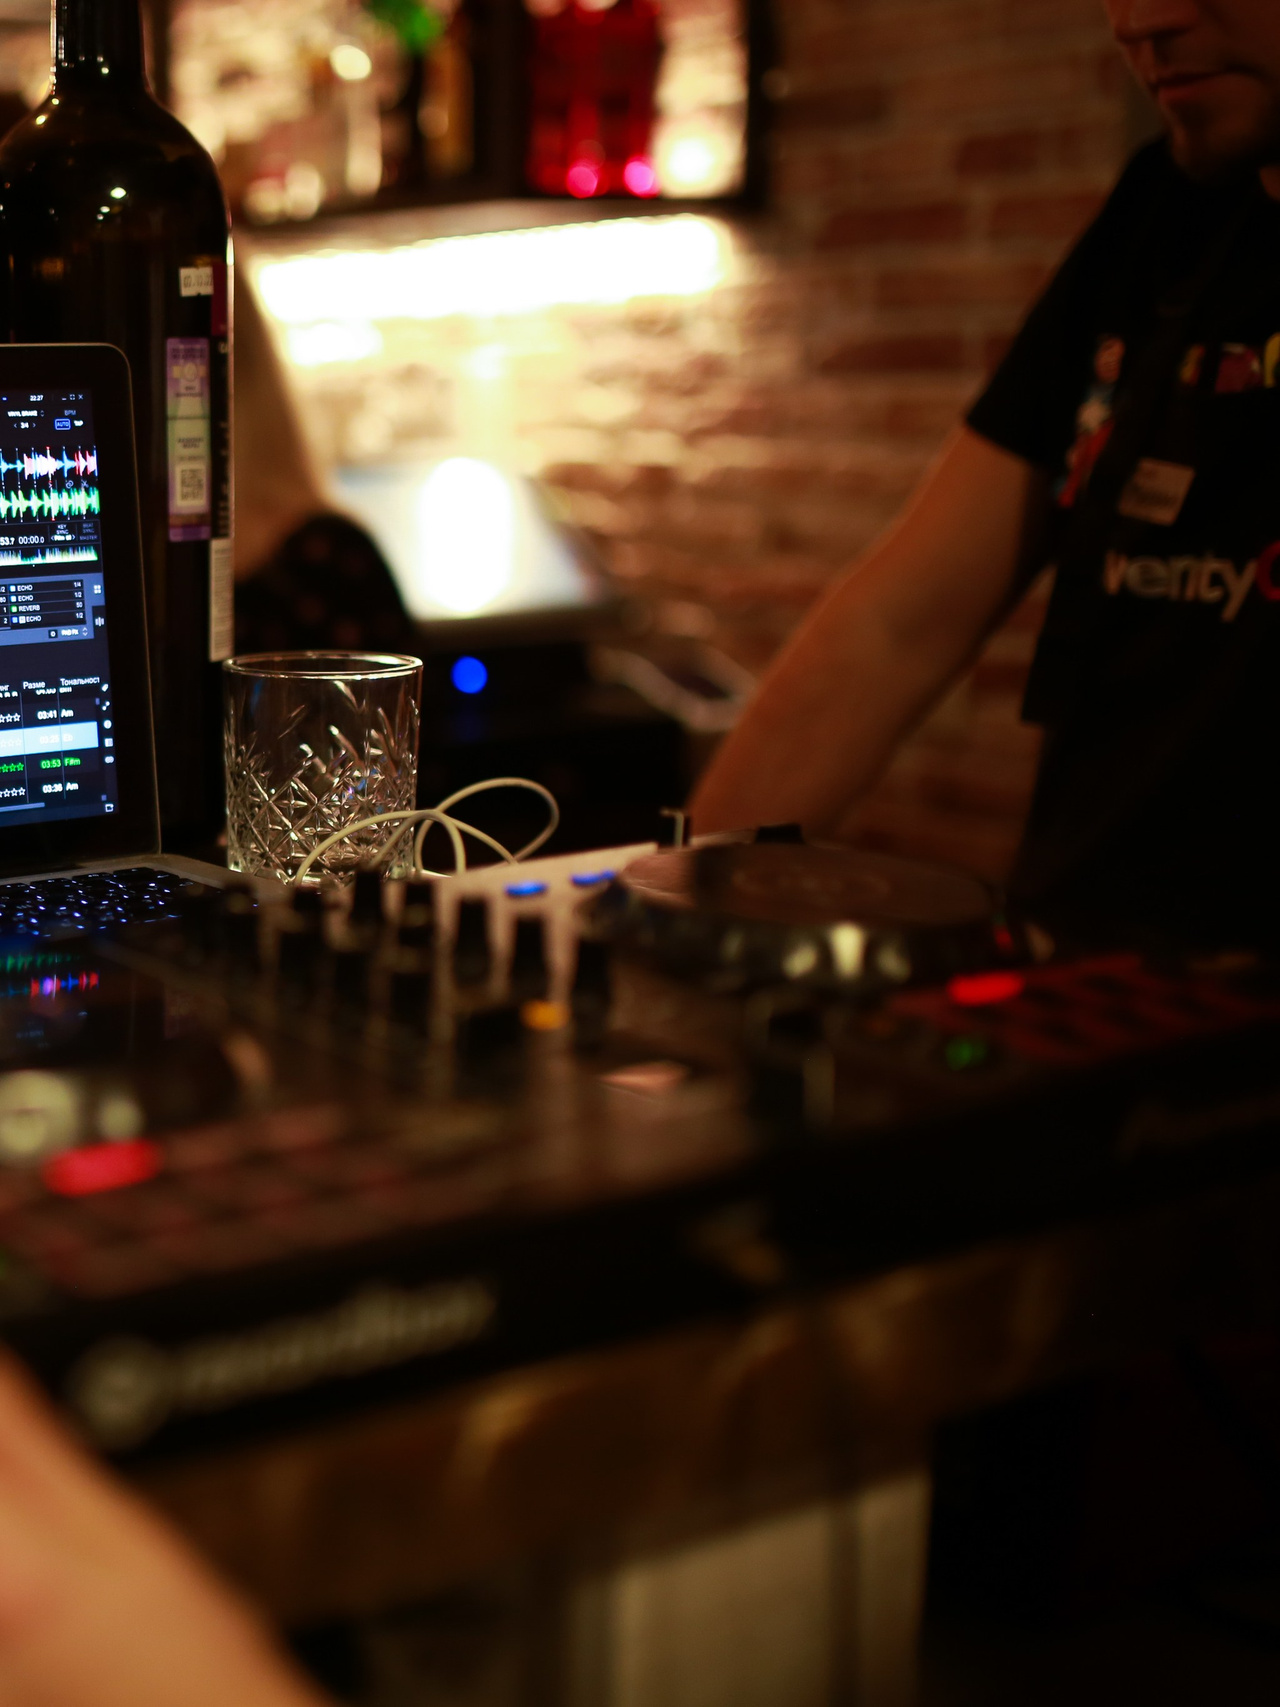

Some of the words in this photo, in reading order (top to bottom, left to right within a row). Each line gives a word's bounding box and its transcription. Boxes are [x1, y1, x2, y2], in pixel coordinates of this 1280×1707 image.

[37, 710, 57, 720] 03:41
[61, 709, 73, 717] Am
[41, 758, 61, 769] 03:53
[64, 757, 81, 766] F#m
[66, 782, 79, 791] Am
